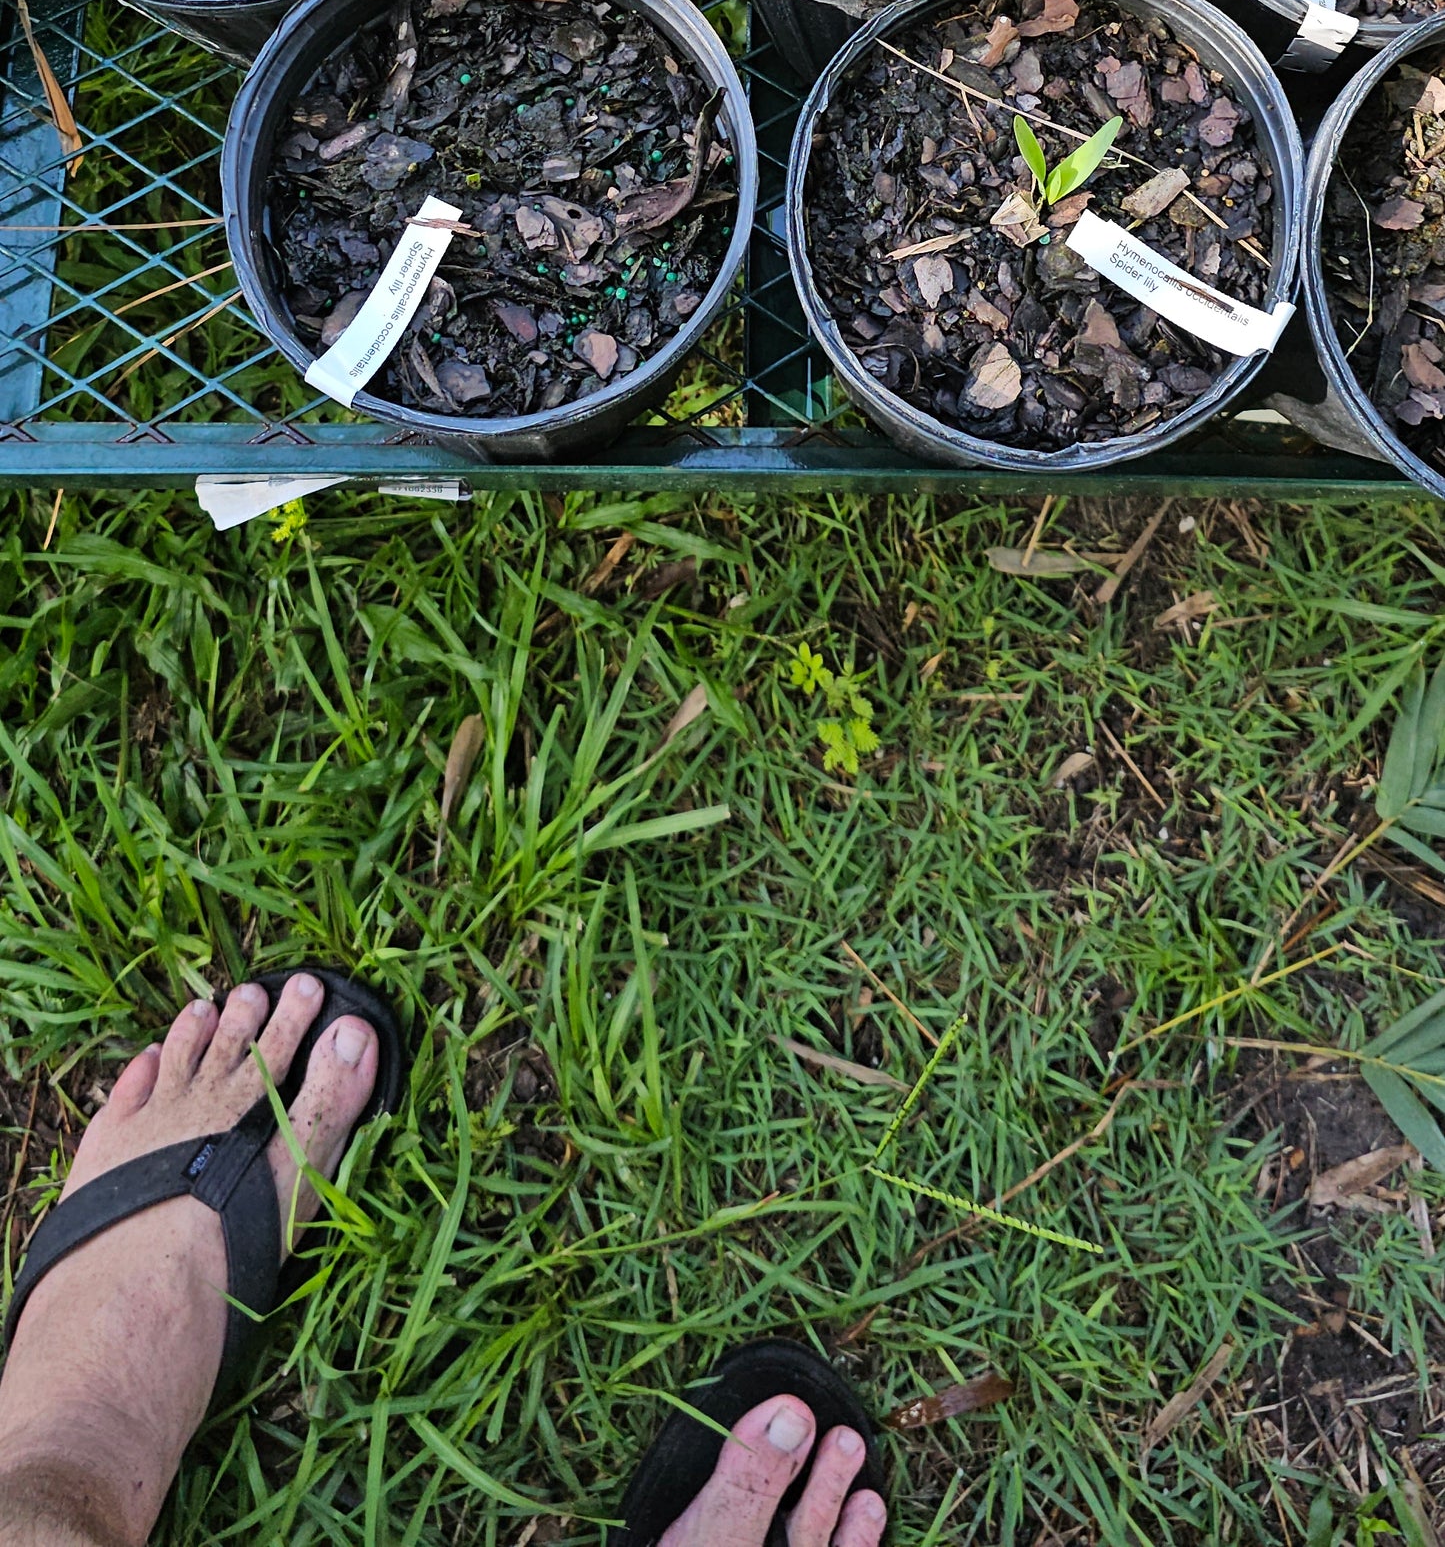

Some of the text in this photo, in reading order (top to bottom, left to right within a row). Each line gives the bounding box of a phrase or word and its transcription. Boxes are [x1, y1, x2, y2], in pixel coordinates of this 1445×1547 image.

[388, 240, 423, 296] Spider lily
[1109, 252, 1159, 293] Spider lily
[1116, 240, 1184, 291] Hymenocallis
[349, 247, 436, 378] Hymenocallis occidentalis
